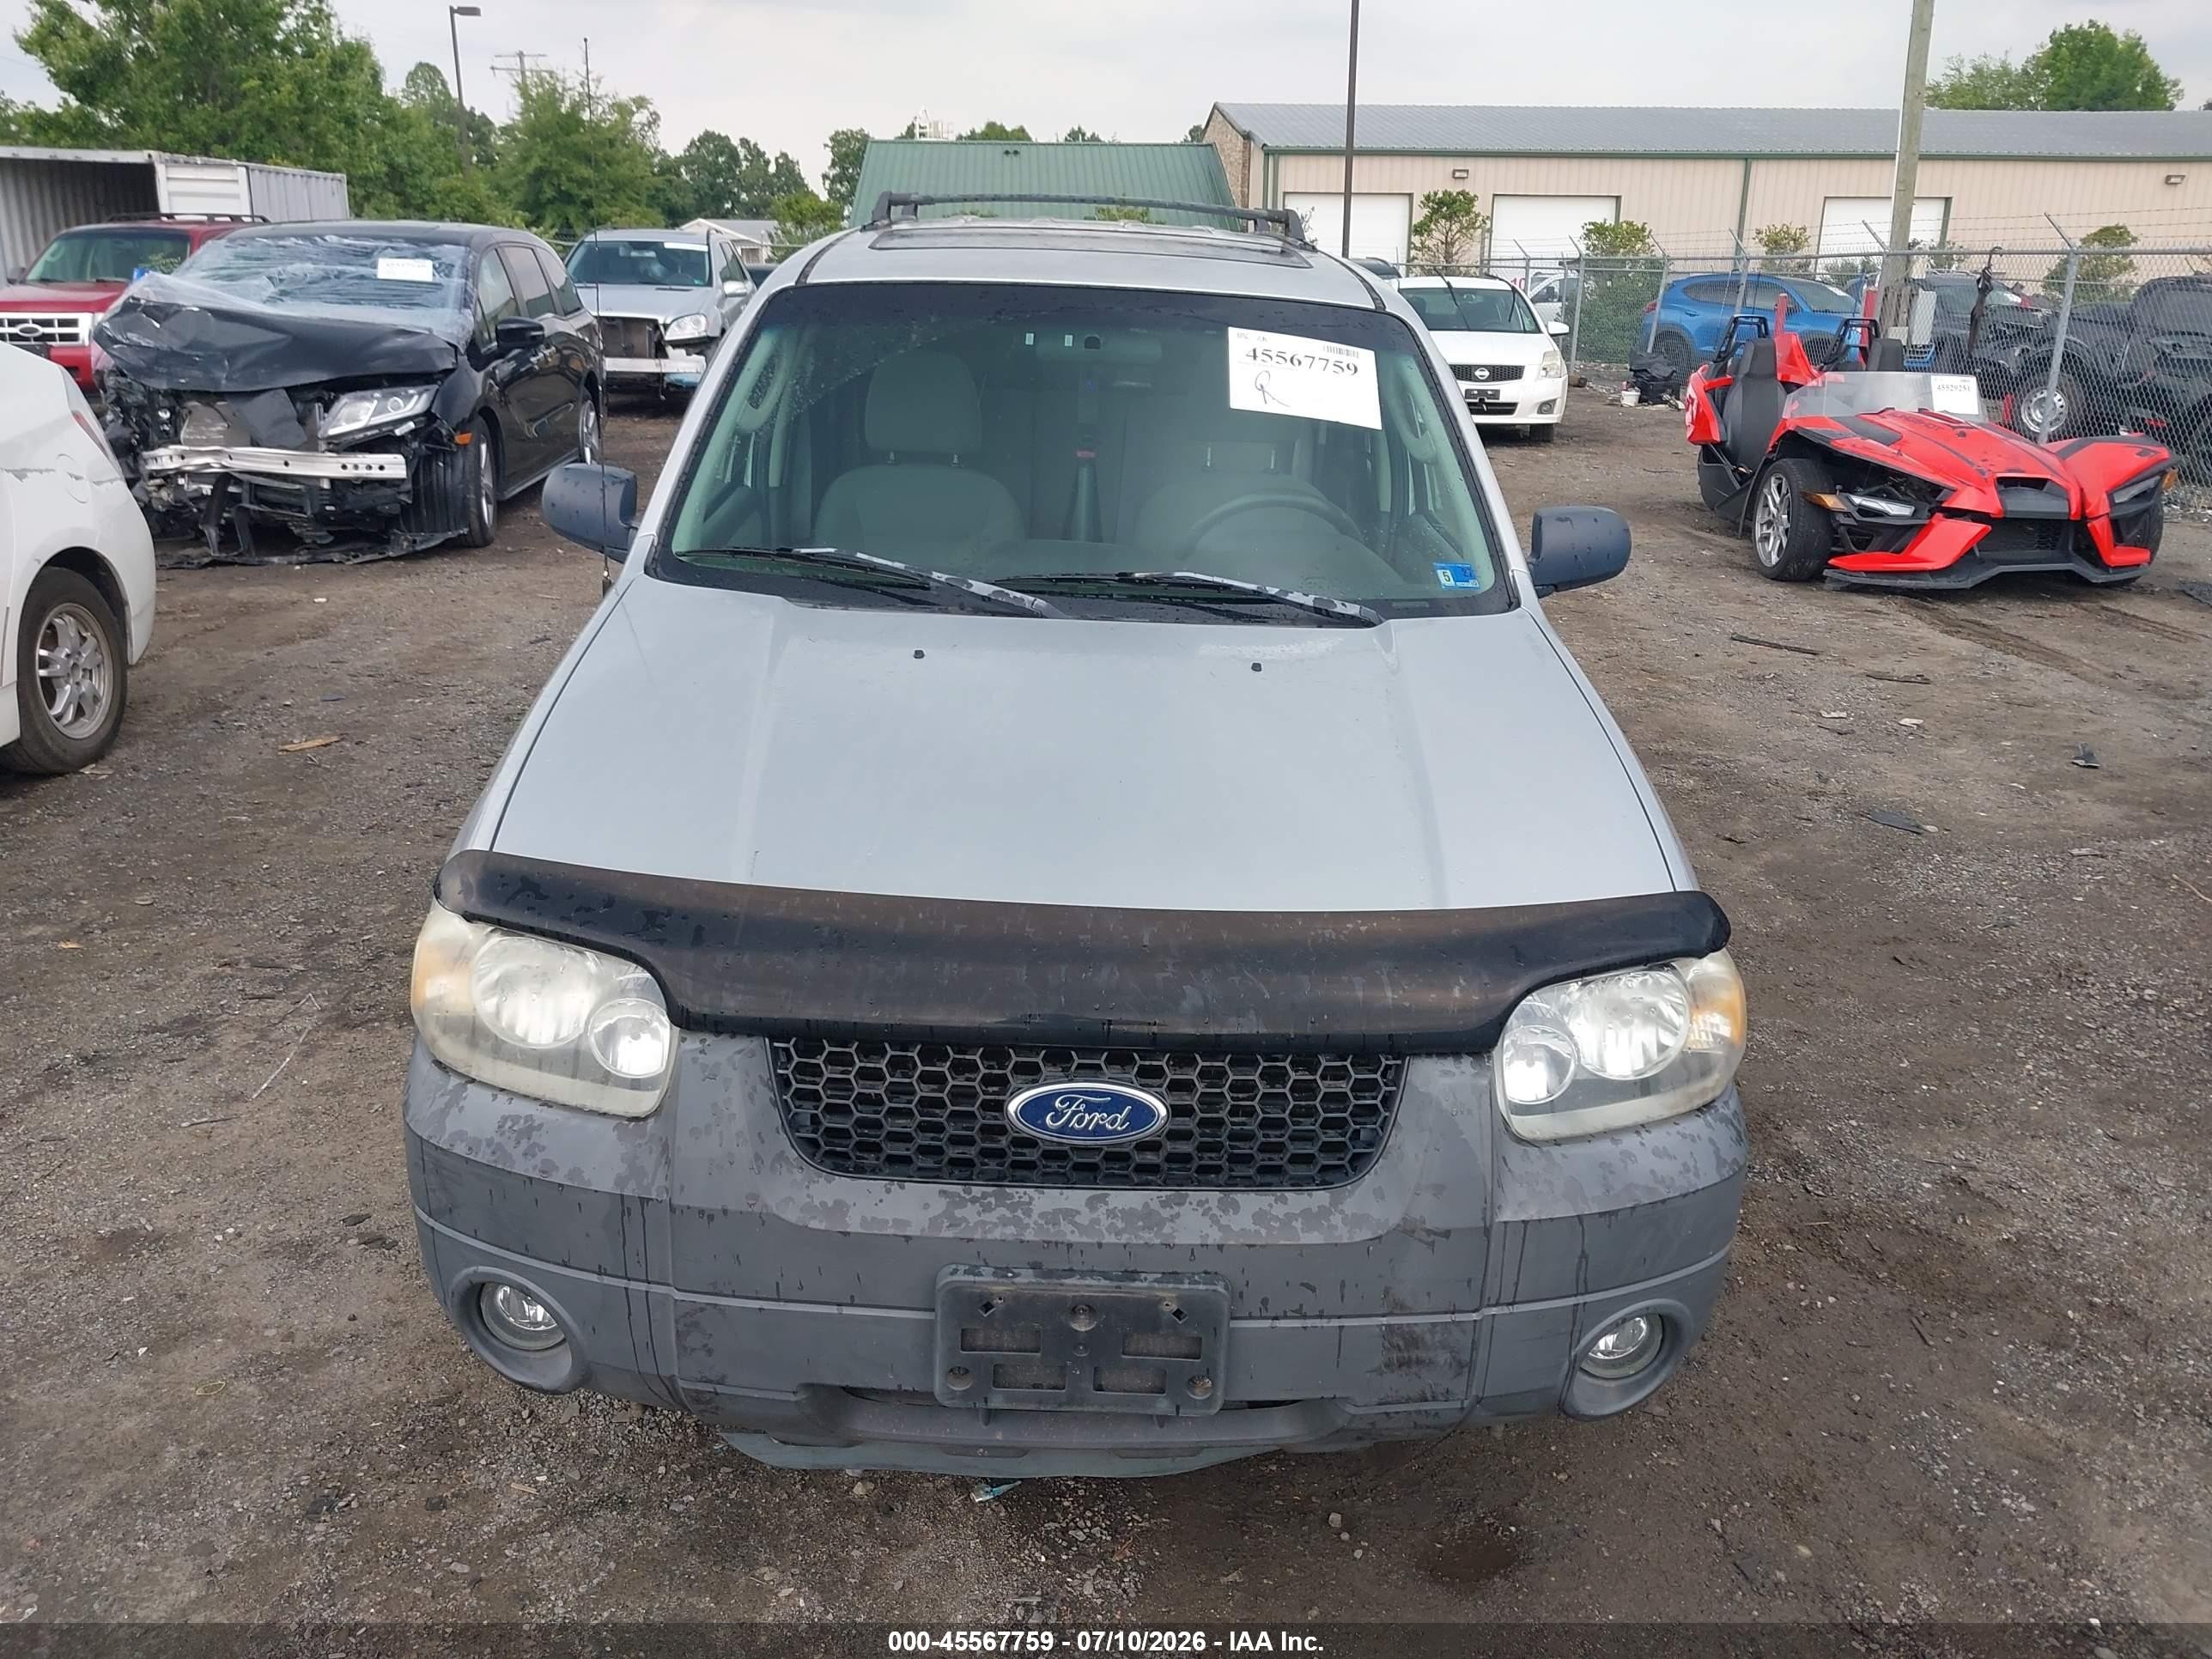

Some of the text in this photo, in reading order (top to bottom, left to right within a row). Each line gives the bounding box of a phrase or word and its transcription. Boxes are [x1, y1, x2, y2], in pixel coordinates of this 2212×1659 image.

[1245, 347, 1358, 376] 45567759
[1442, 571, 1451, 582] 5
[1045, 1094, 1132, 1131] Ford
